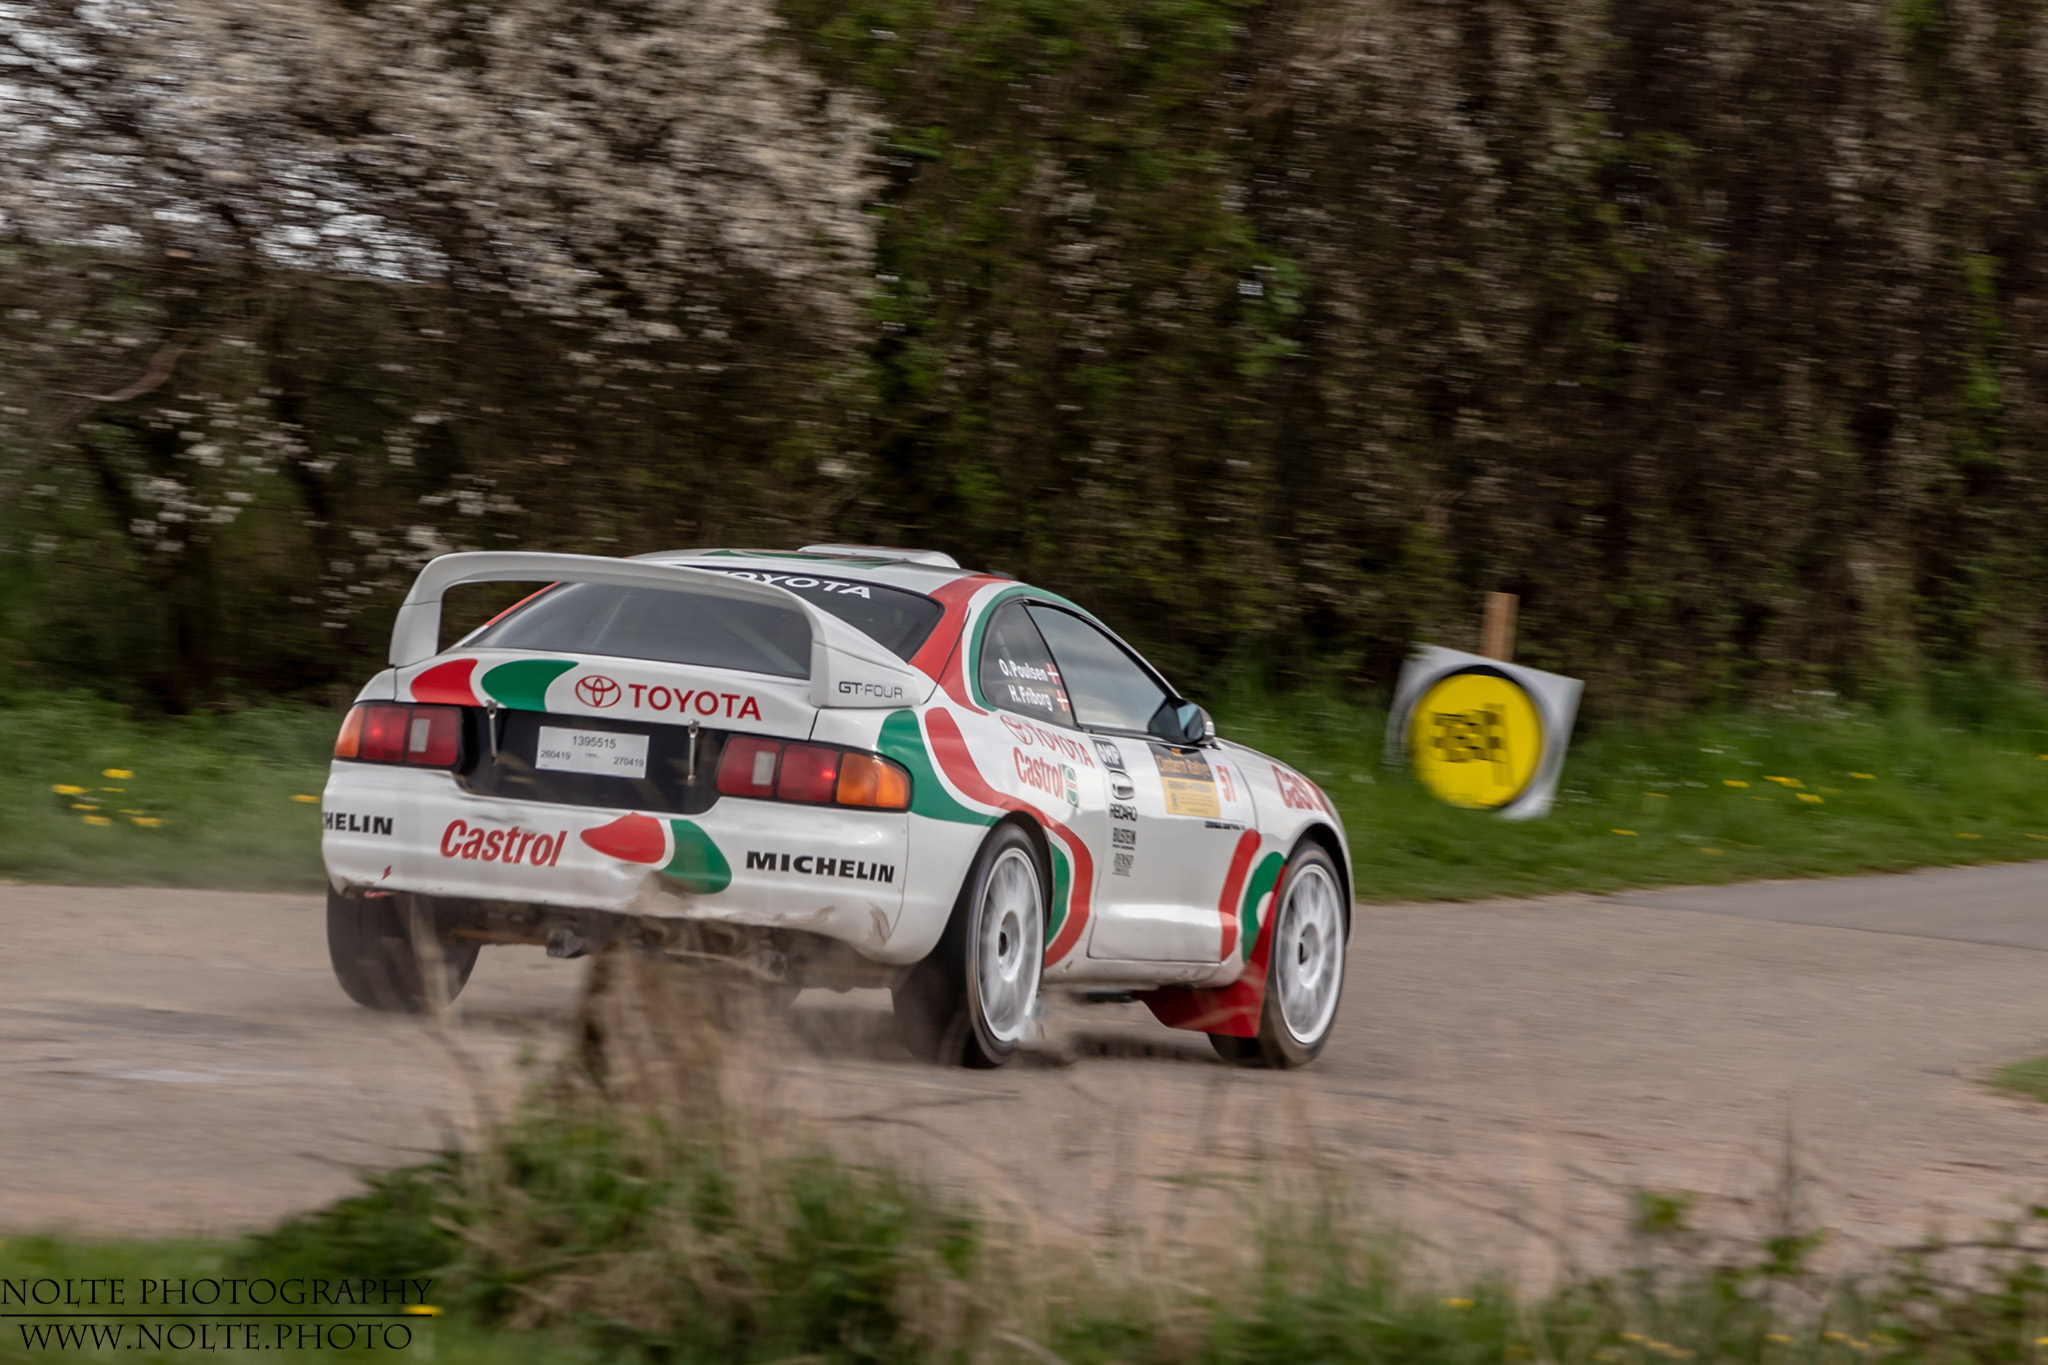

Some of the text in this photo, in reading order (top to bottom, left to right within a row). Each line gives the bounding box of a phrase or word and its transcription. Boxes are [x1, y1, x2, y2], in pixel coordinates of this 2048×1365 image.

[628, 683, 762, 721] TOYOTA
[540, 749, 571, 761] 260419
[613, 756, 644, 768] 270419
[572, 735, 617, 750] 1395515
[1024, 722, 1096, 770] TOYOTA
[1013, 745, 1064, 801] Castrol
[1215, 765, 1238, 803] 51
[1109, 803, 1138, 822] RECARO
[440, 818, 568, 867] Castrol
[746, 850, 895, 884] MICHELIN
